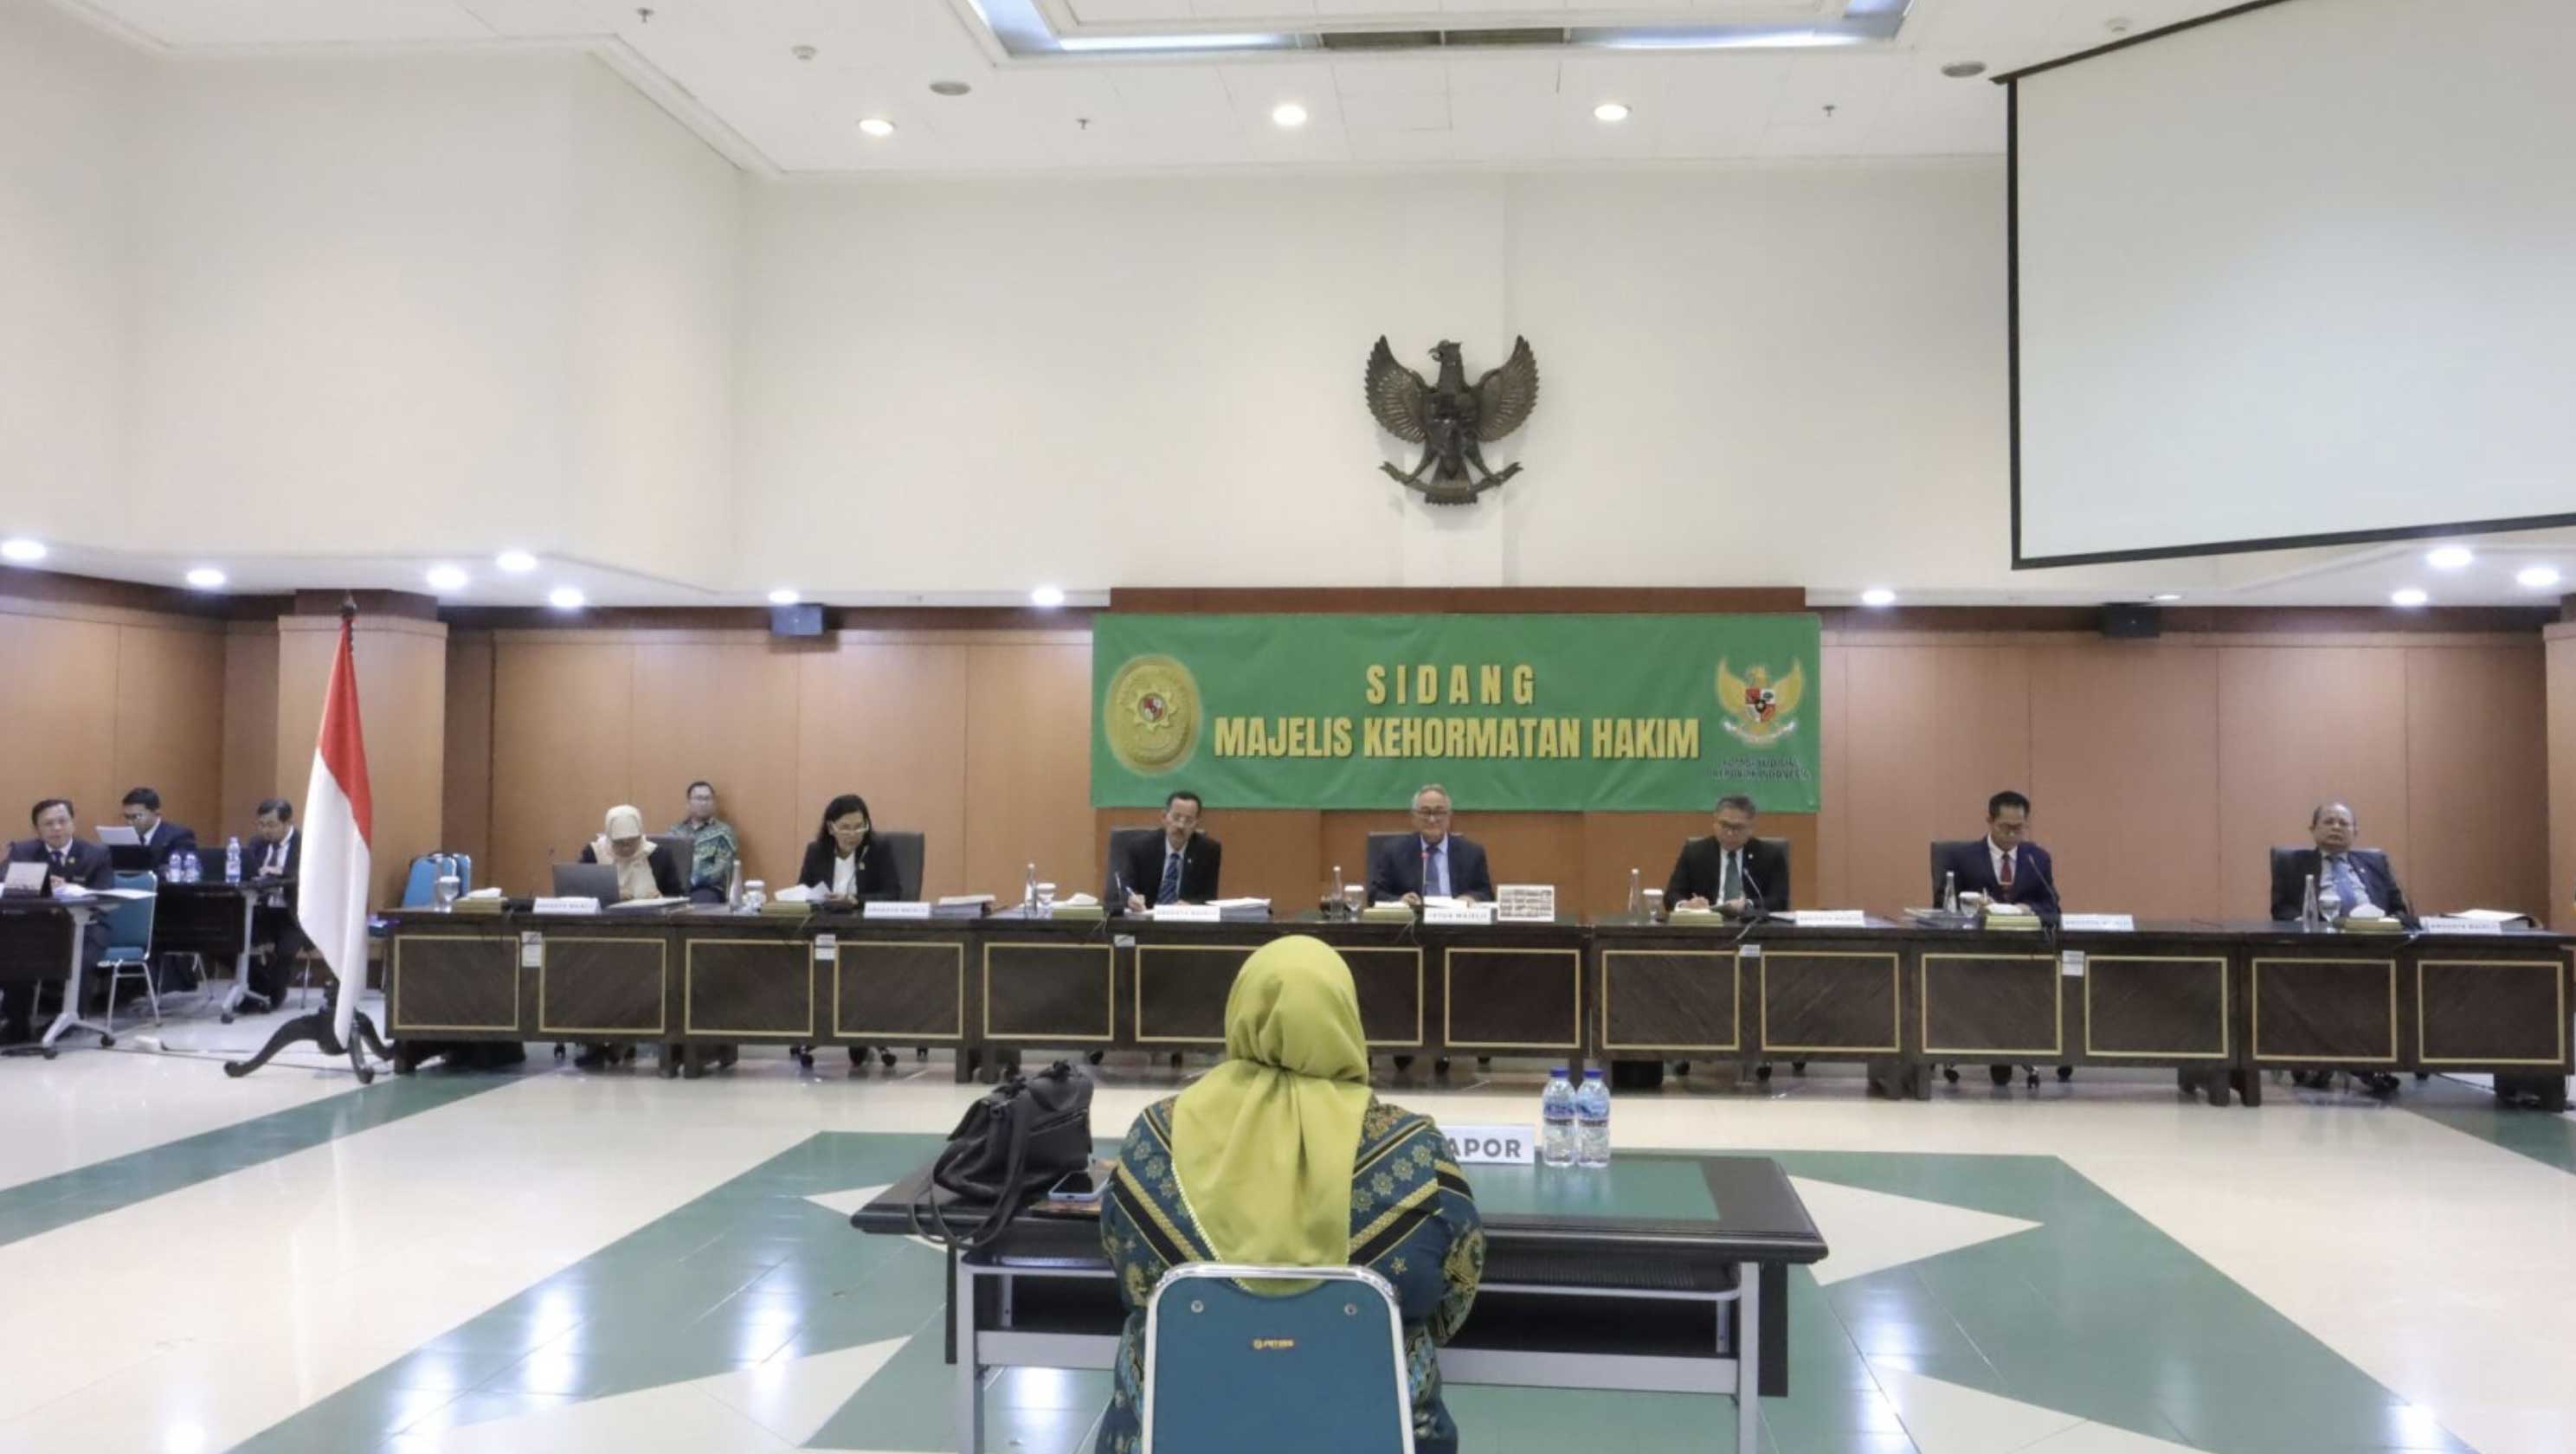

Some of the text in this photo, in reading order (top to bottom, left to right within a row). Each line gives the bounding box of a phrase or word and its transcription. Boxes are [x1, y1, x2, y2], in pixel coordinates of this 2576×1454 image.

[1365, 664, 1535, 705] SIDANG
[1214, 717, 1700, 759] MAJELIS KEHORMATAN HAKIM
